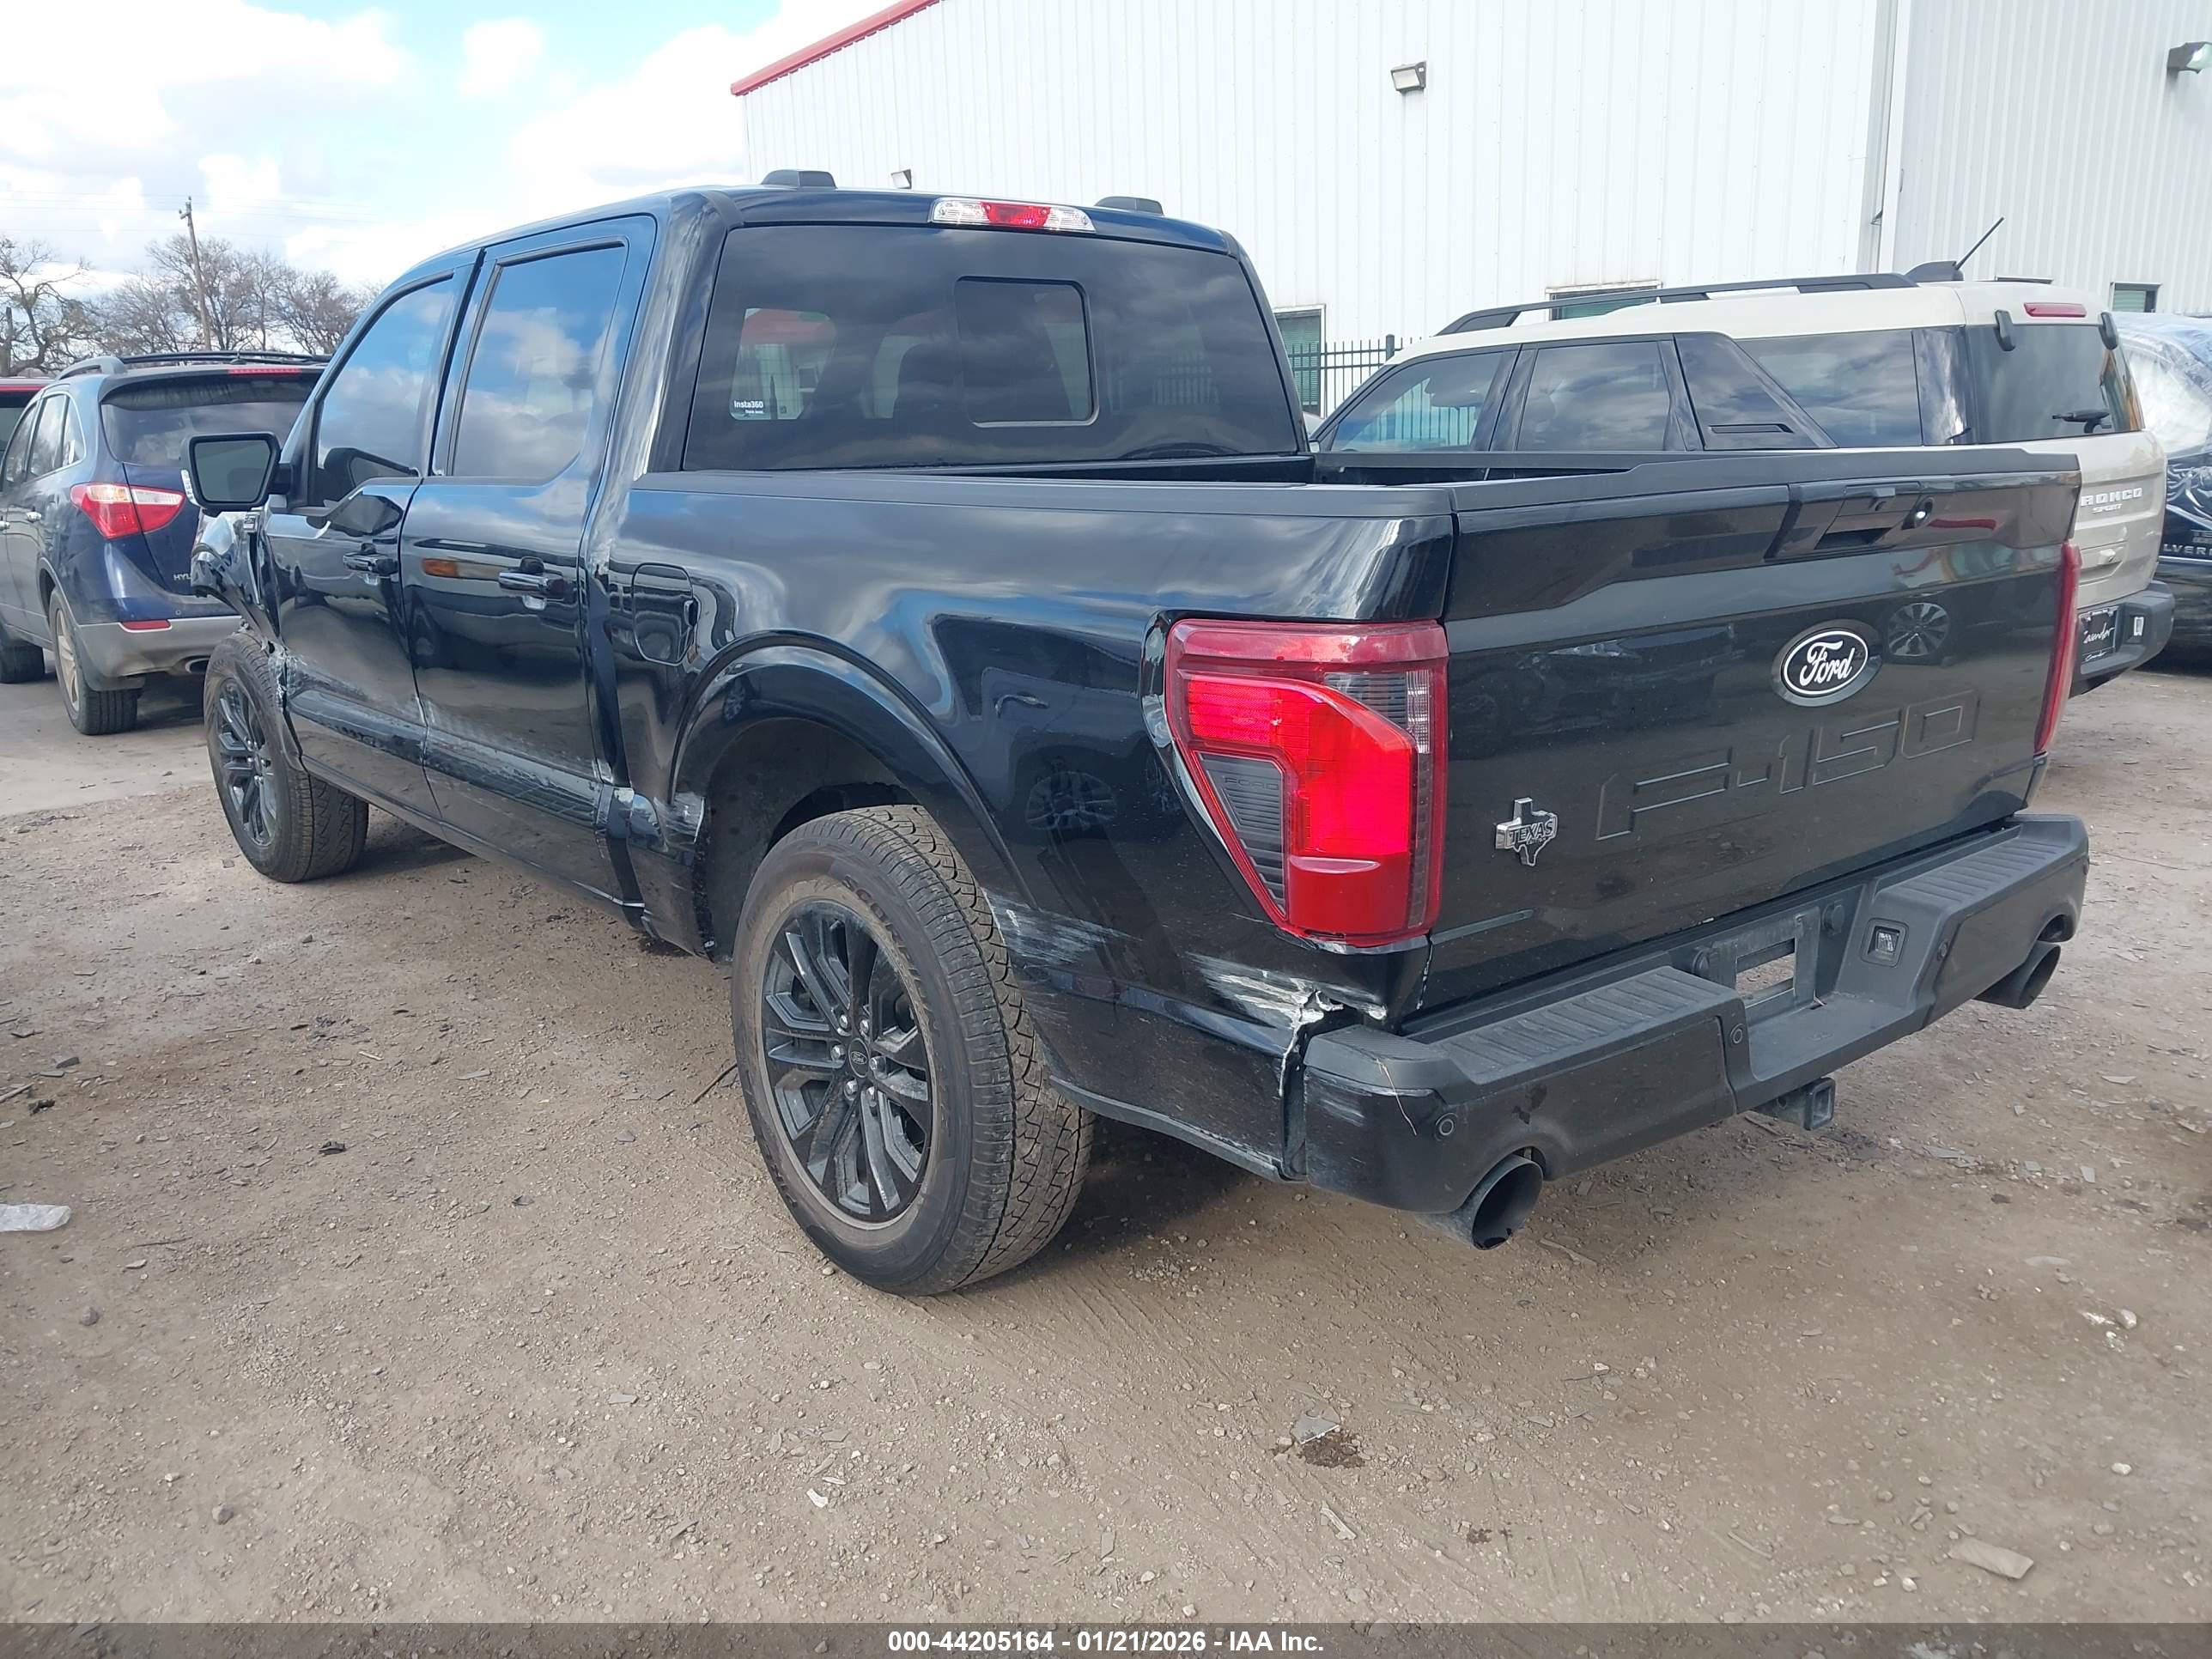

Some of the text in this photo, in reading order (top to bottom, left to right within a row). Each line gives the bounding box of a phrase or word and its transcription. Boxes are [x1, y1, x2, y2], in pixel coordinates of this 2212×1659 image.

[1799, 640, 1856, 687] Ford
[1224, 777, 1279, 790] FORD
[1595, 690, 1980, 842] F-150
[1509, 817, 1553, 845] TEXAS
